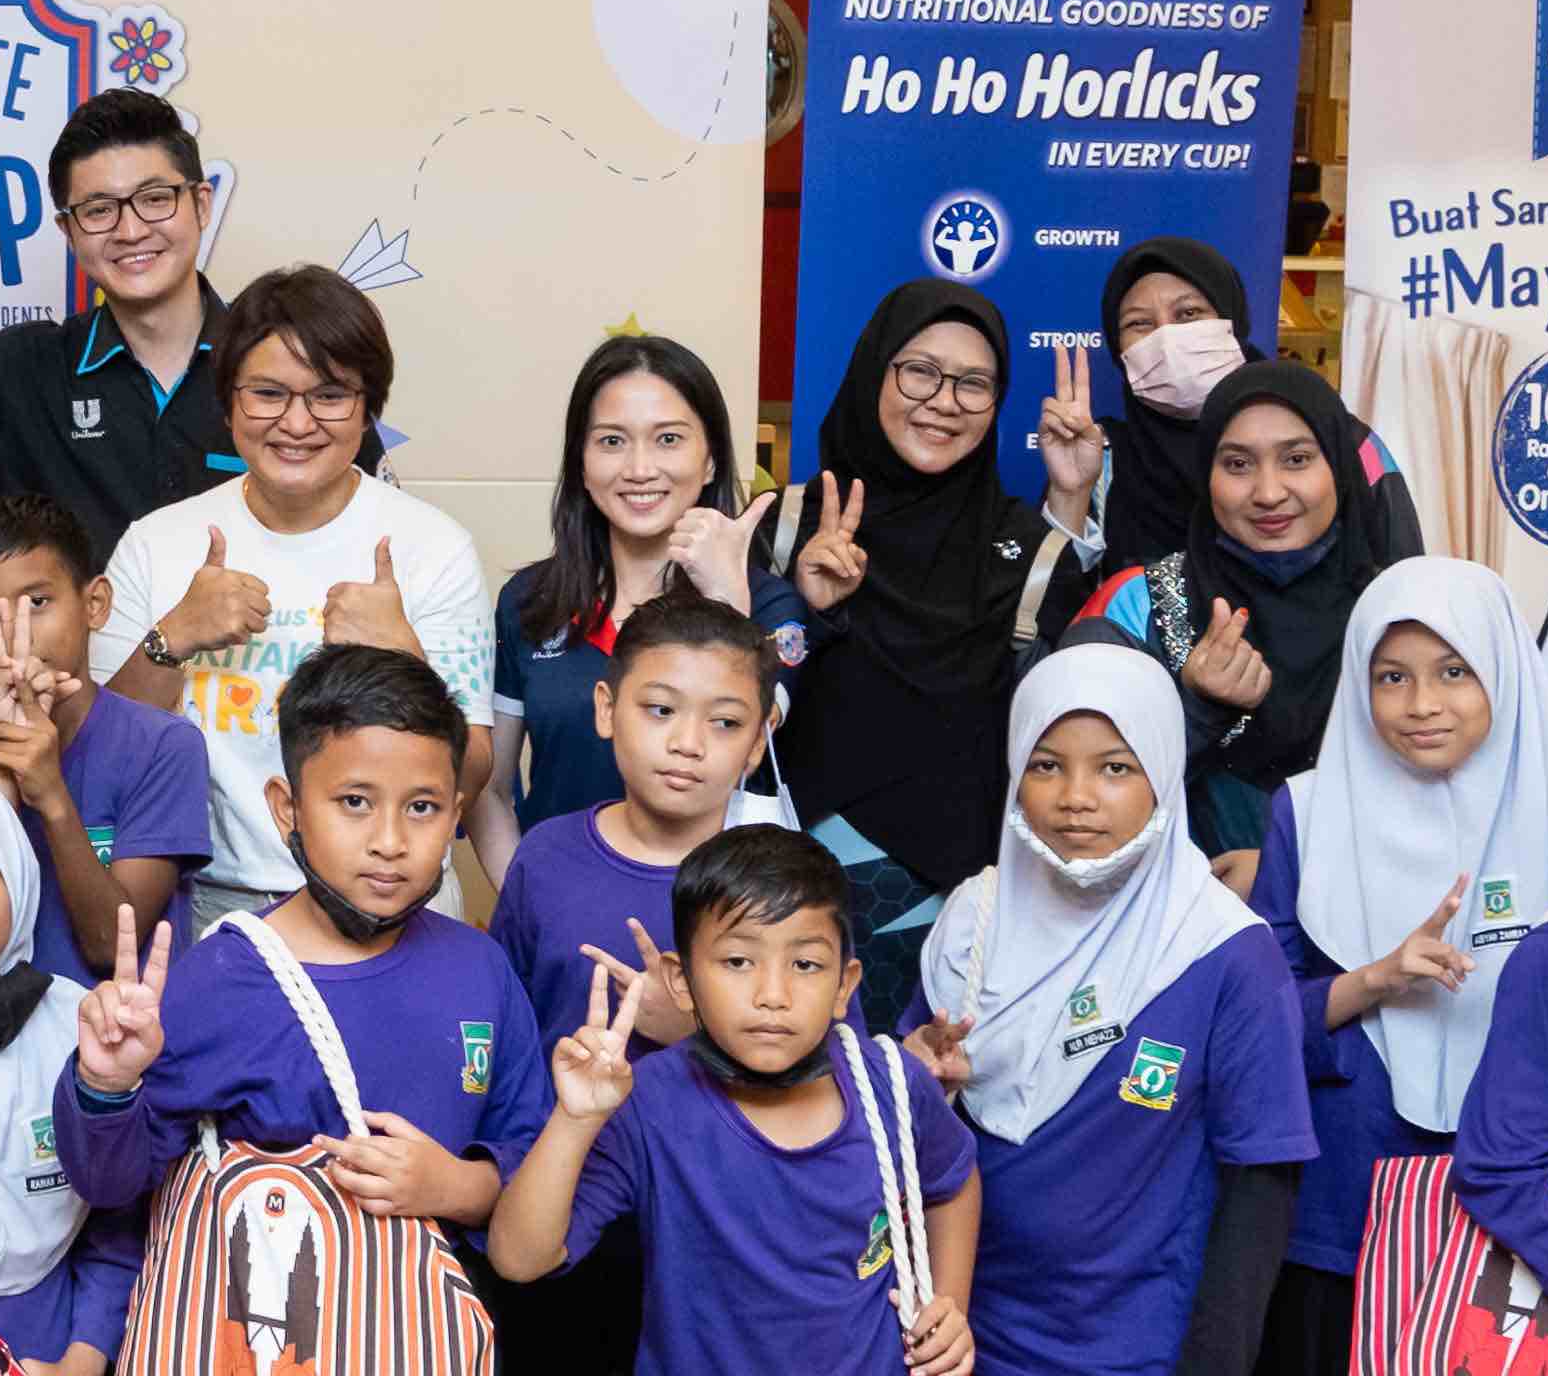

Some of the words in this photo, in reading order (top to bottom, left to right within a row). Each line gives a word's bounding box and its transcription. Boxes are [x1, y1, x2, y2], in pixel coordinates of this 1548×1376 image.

[1061, 0, 1224, 30] GOODNESS
[1230, 4, 1271, 32] OF
[842, 55, 921, 115] Ho
[931, 55, 1006, 116] Ho
[1015, 47, 1261, 127] Horlicks
[1048, 141, 1081, 167] IN
[1085, 142, 1181, 170] EVERY
[1184, 143, 1251, 170] CUP!
[1390, 192, 1480, 239] Buat
[1034, 229, 1119, 249] GROWTH
[1029, 331, 1102, 349] STRONG
